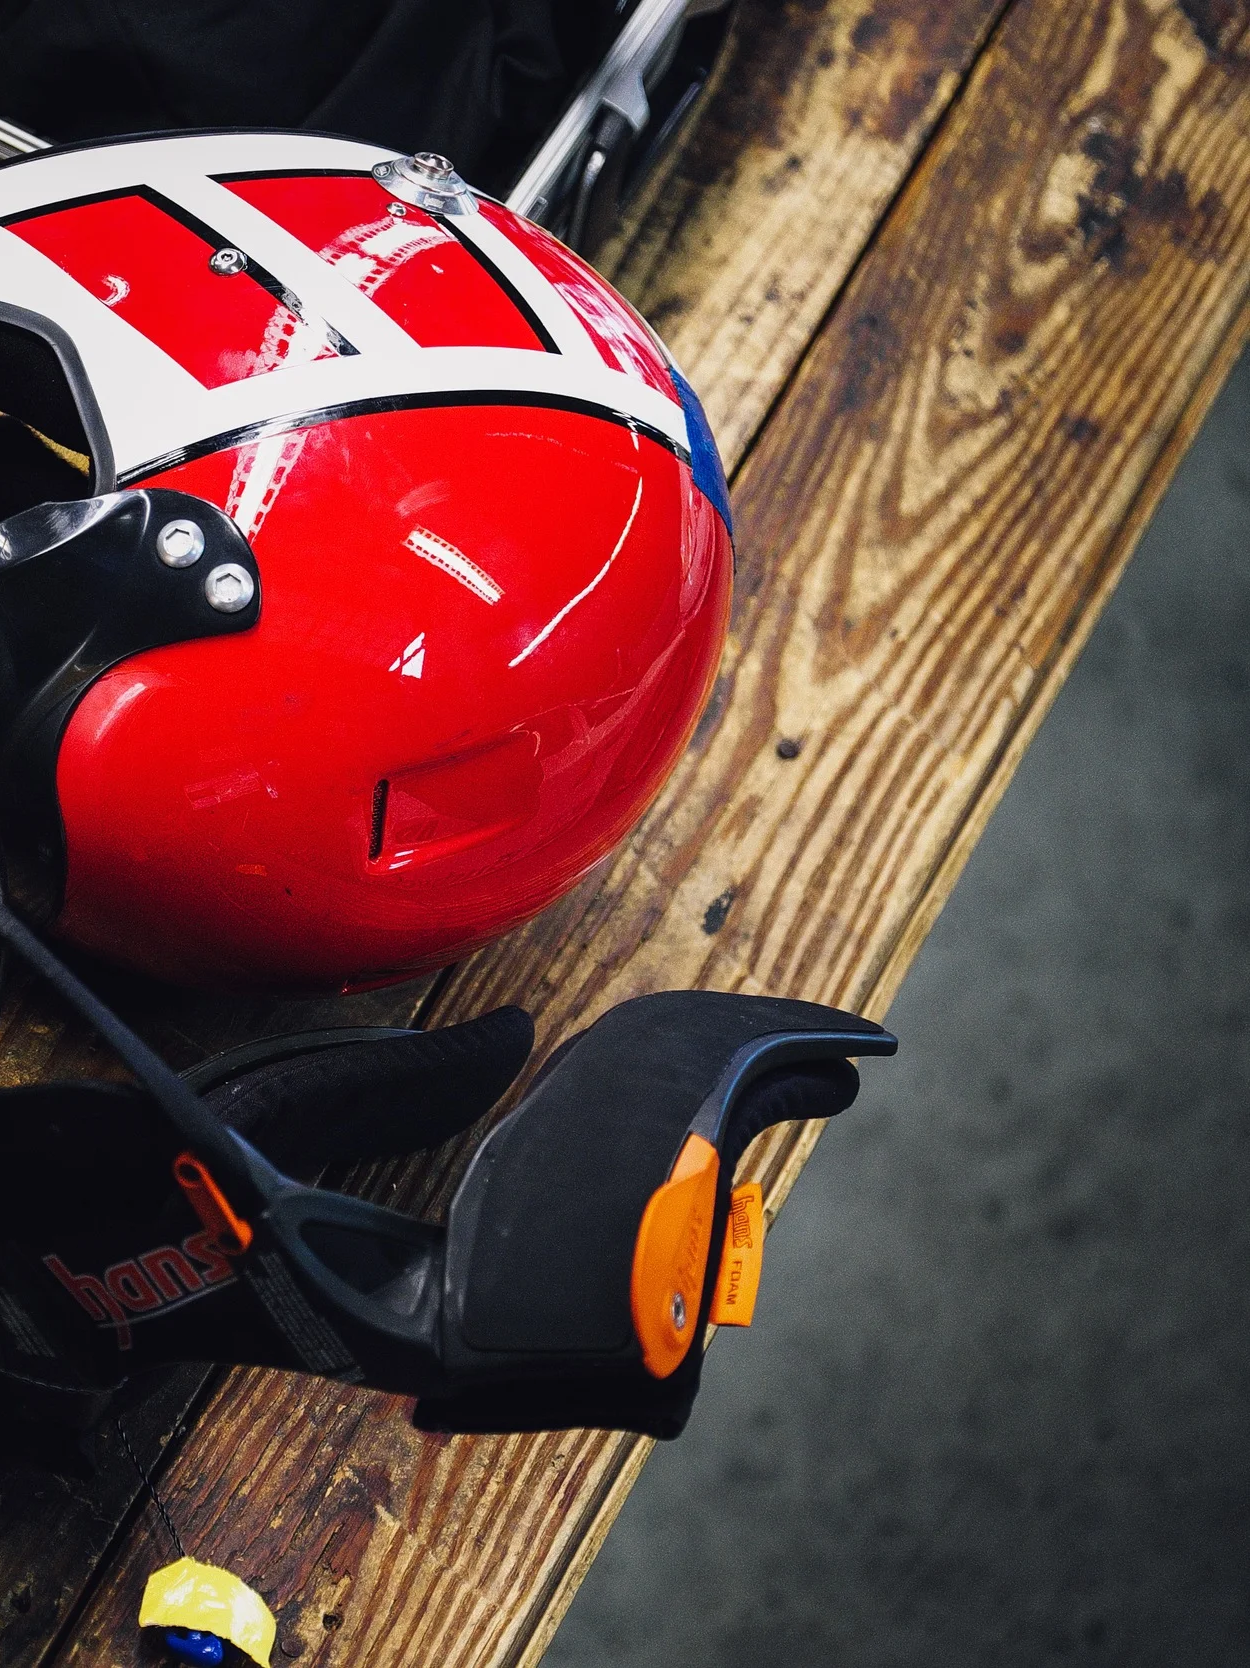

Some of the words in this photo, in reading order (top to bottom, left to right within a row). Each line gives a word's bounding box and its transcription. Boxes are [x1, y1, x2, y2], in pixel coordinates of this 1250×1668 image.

[729, 1196, 754, 1249] hans
[43, 1230, 235, 1350] hans
[726, 1260, 742, 1305] FOAM
